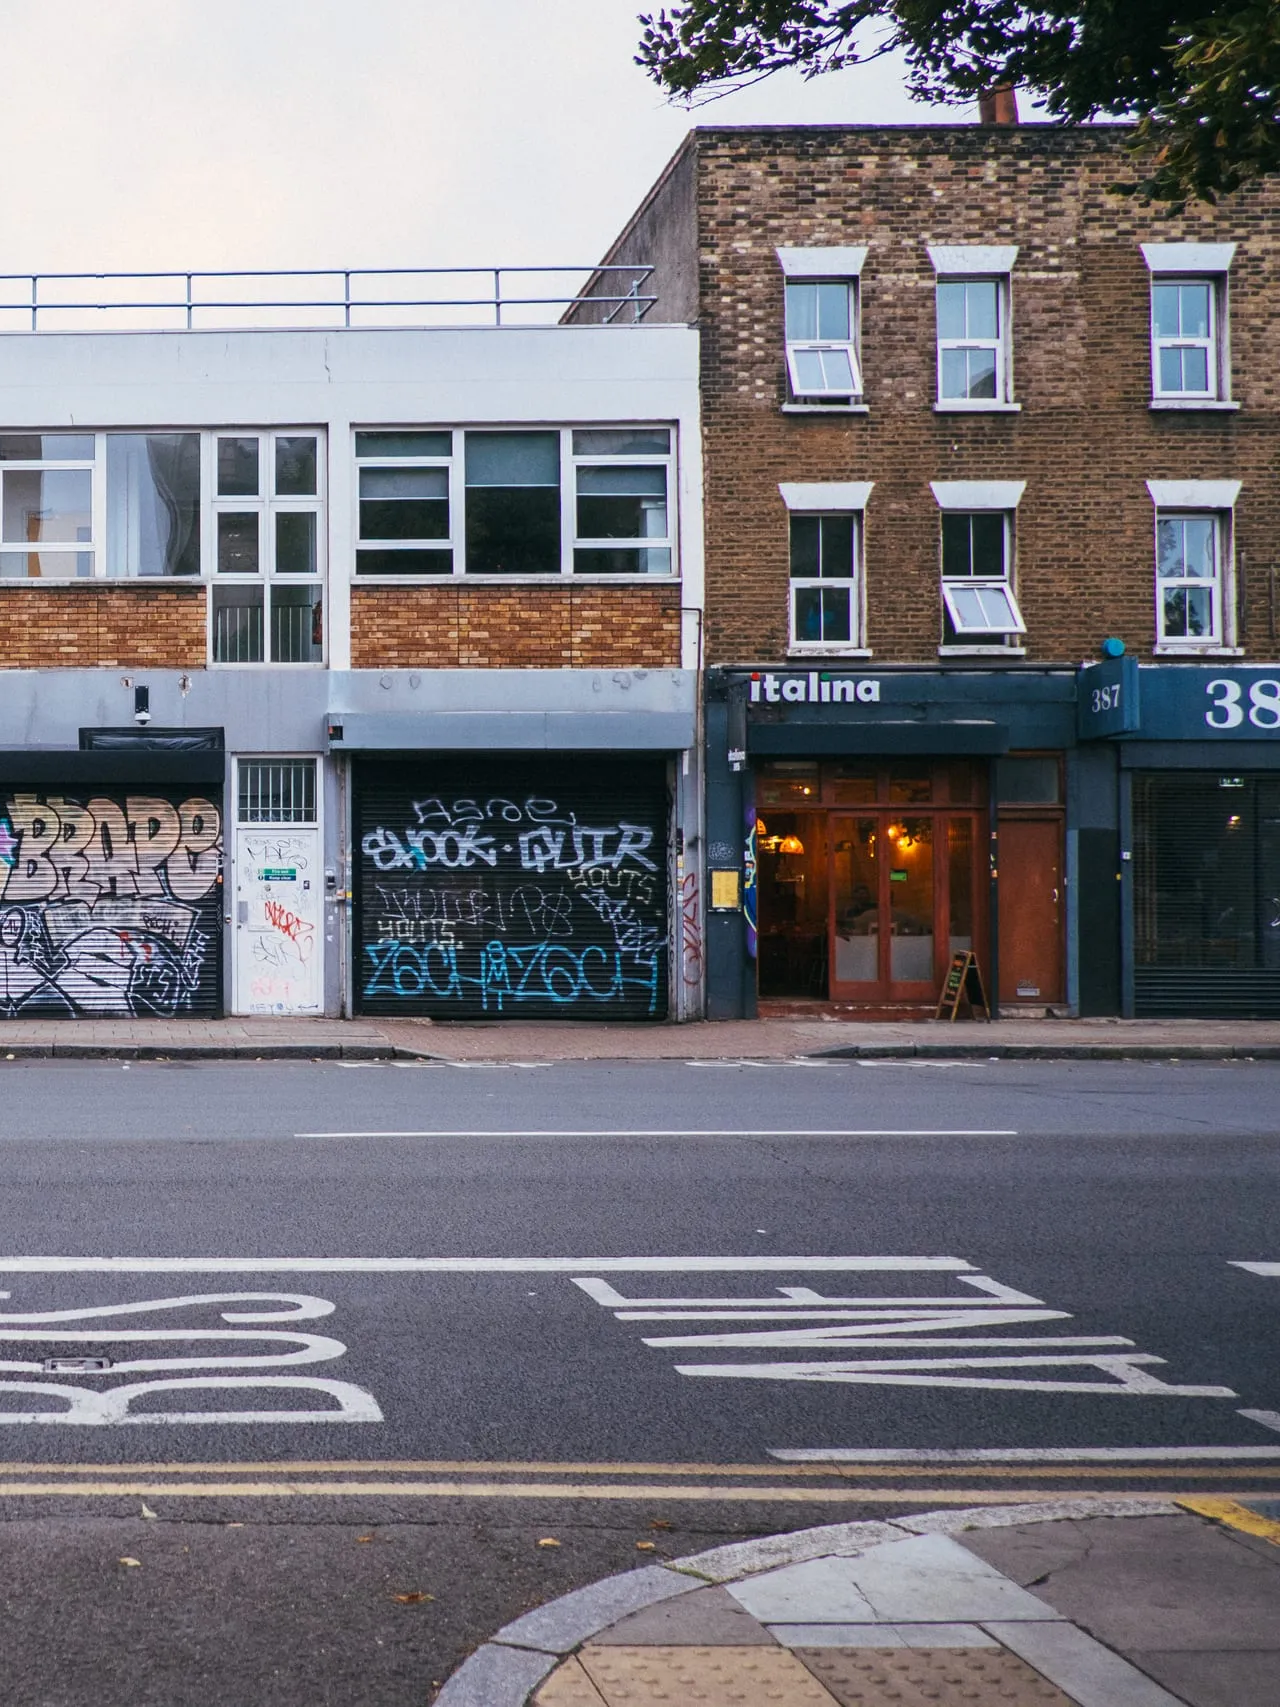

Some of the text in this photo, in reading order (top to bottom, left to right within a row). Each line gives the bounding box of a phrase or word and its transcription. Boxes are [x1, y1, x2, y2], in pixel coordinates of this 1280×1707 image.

[750, 672, 880, 702] italina
[1091, 684, 1120, 712] 387
[570, 1275, 1280, 1462] LANE
